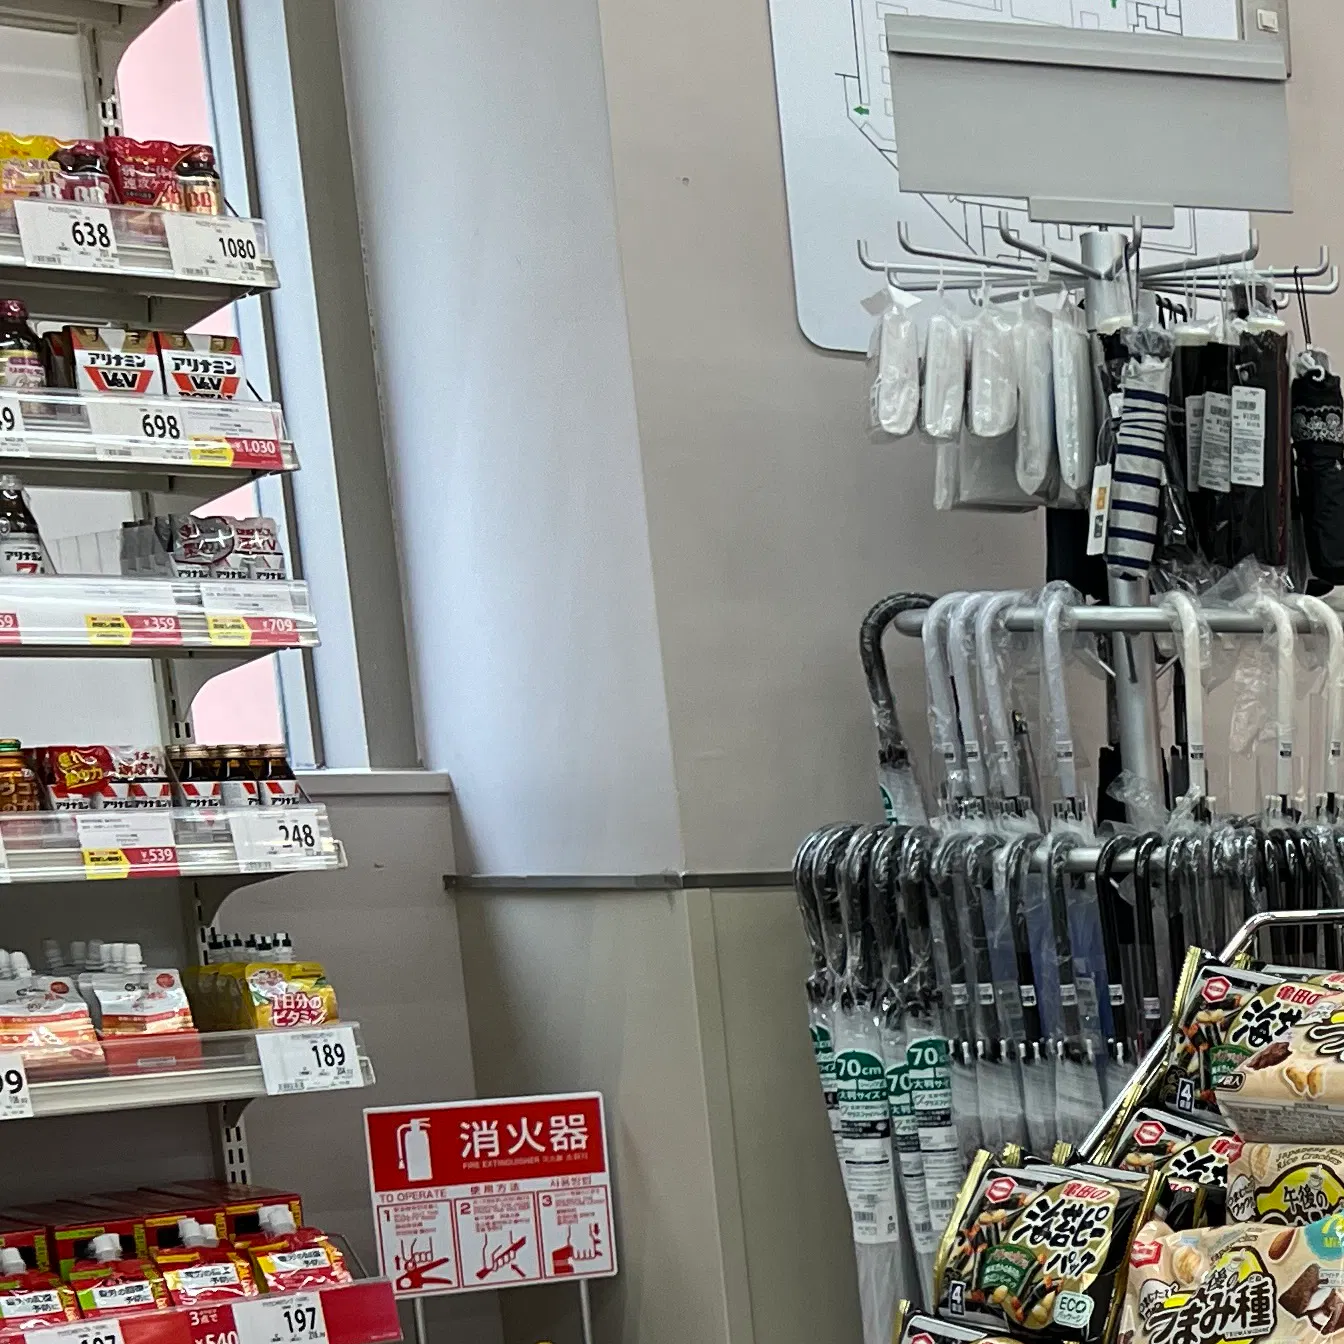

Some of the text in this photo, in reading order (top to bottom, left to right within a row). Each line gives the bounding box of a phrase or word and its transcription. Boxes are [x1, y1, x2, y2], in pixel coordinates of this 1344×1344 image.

[72, 222, 111, 248] 638
[219, 236, 255, 260] 1080
[141, 415, 180, 439] 698
[278, 825, 314, 848] 248
[311, 1043, 345, 1069] 189
[460, 1113, 589, 1159] 消火器
[542, 1195, 552, 1207] 3
[1061, 1182, 1112, 1199] 亀田の
[1282, 1185, 1327, 1212] 午後の
[460, 1203, 471, 1215] 2
[1044, 1251, 1096, 1277] パック
[1059, 1292, 1086, 1313] ECO
[284, 1307, 316, 1333] 197
